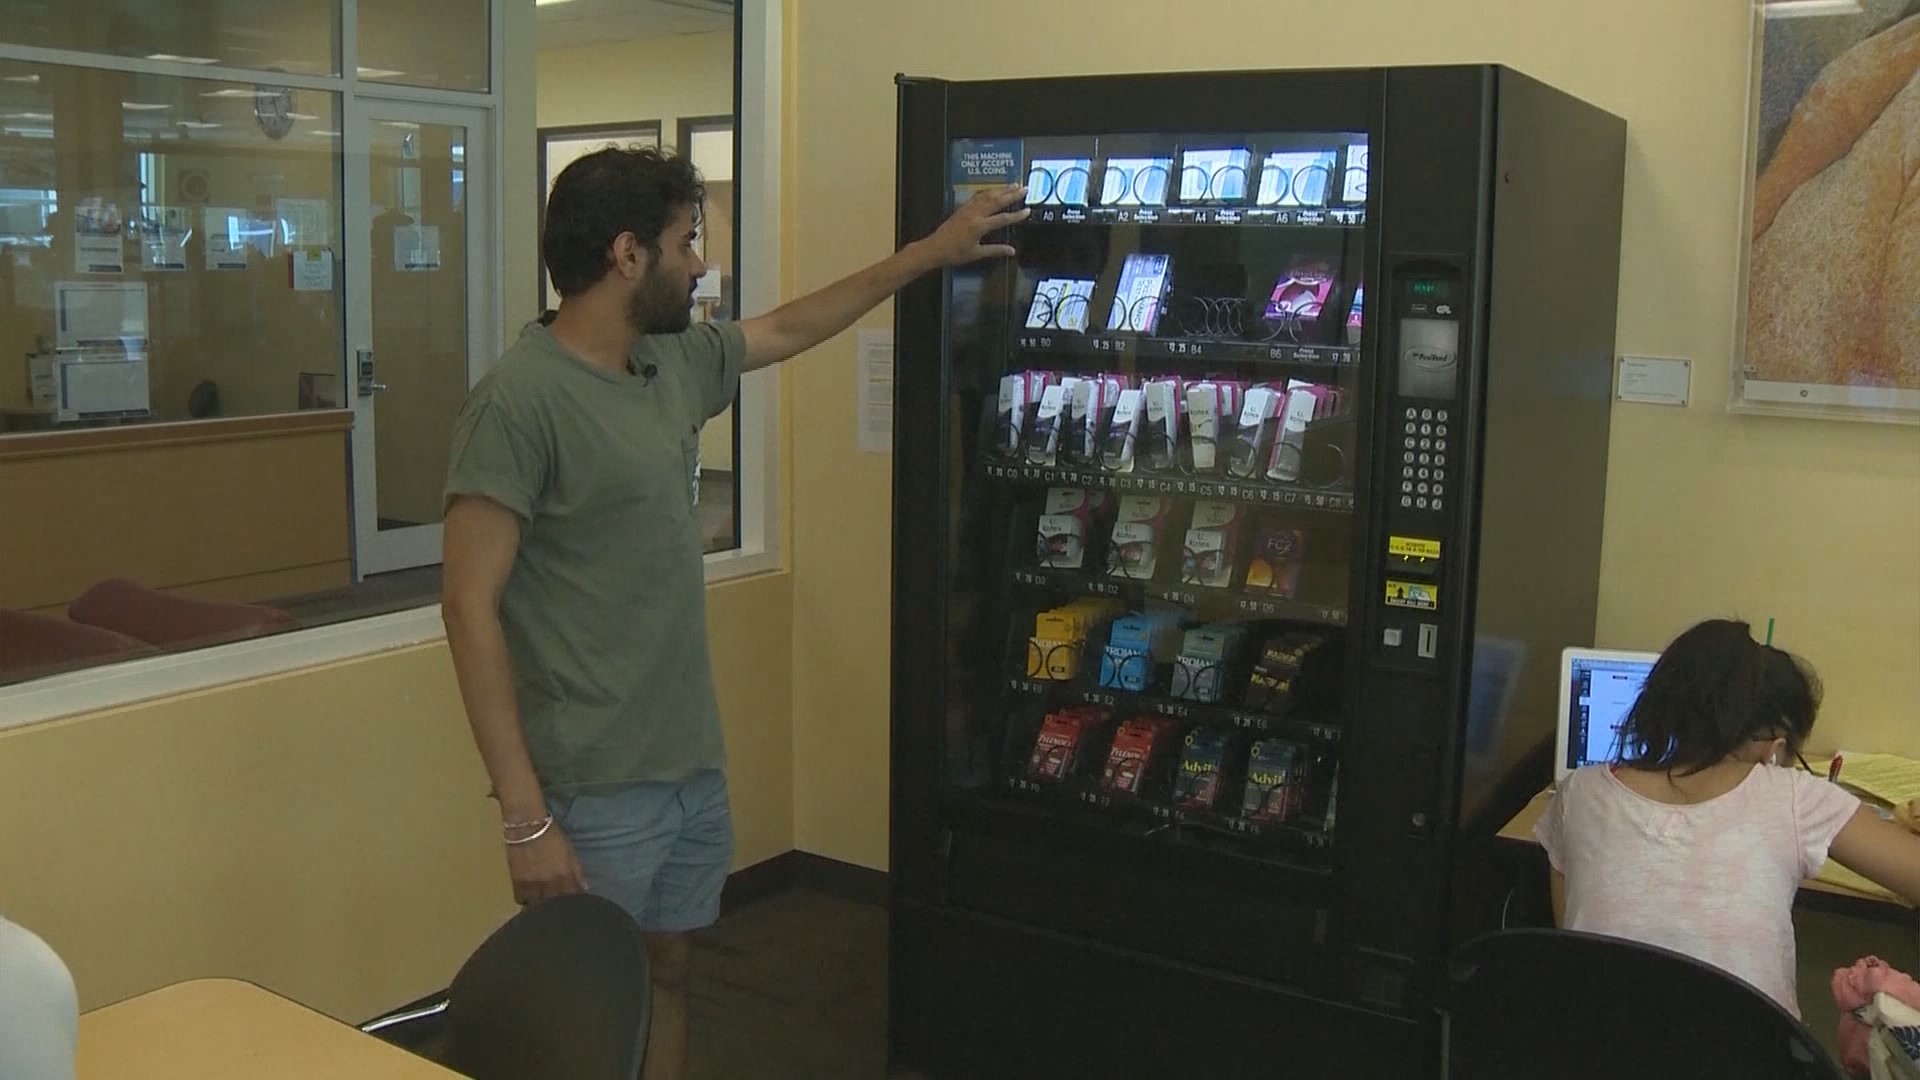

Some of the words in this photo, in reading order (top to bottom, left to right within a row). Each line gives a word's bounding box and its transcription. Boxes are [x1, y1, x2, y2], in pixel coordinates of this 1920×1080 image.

[964, 152, 979, 161] THIS
[980, 151, 1012, 160] MACHINE
[961, 160, 980, 168] ONLY
[981, 159, 1015, 167] ACCEPTS
[967, 167, 981, 175] U.S.
[1043, 211, 1054, 222] A0
[1118, 211, 1129, 222] A2
[1195, 212, 1206, 223] A4
[1276, 213, 1289, 224] A6
[1114, 340, 1126, 351] B2
[1191, 345, 1202, 355] B4
[1270, 348, 1281, 359] B6
[1007, 468, 1017, 479] C0
[1045, 471, 1054, 481] C1
[1082, 475, 1092, 485] C2
[1120, 479, 1131, 488] C3
[1160, 482, 1170, 492] C4
[1200, 485, 1211, 496] C5
[1242, 489, 1254, 500] C6
[1284, 492, 1297, 503] C7
[1329, 496, 1341, 508] C8
[1267, 538, 1292, 551] FC2
[1108, 585, 1119, 595] D2
[1105, 645, 1142, 657] TROJAN
[1176, 655, 1215, 667] TROJAN
[1104, 695, 1115, 705] E2
[1183, 759, 1212, 773] Advil
[1251, 771, 1282, 786] Advil
